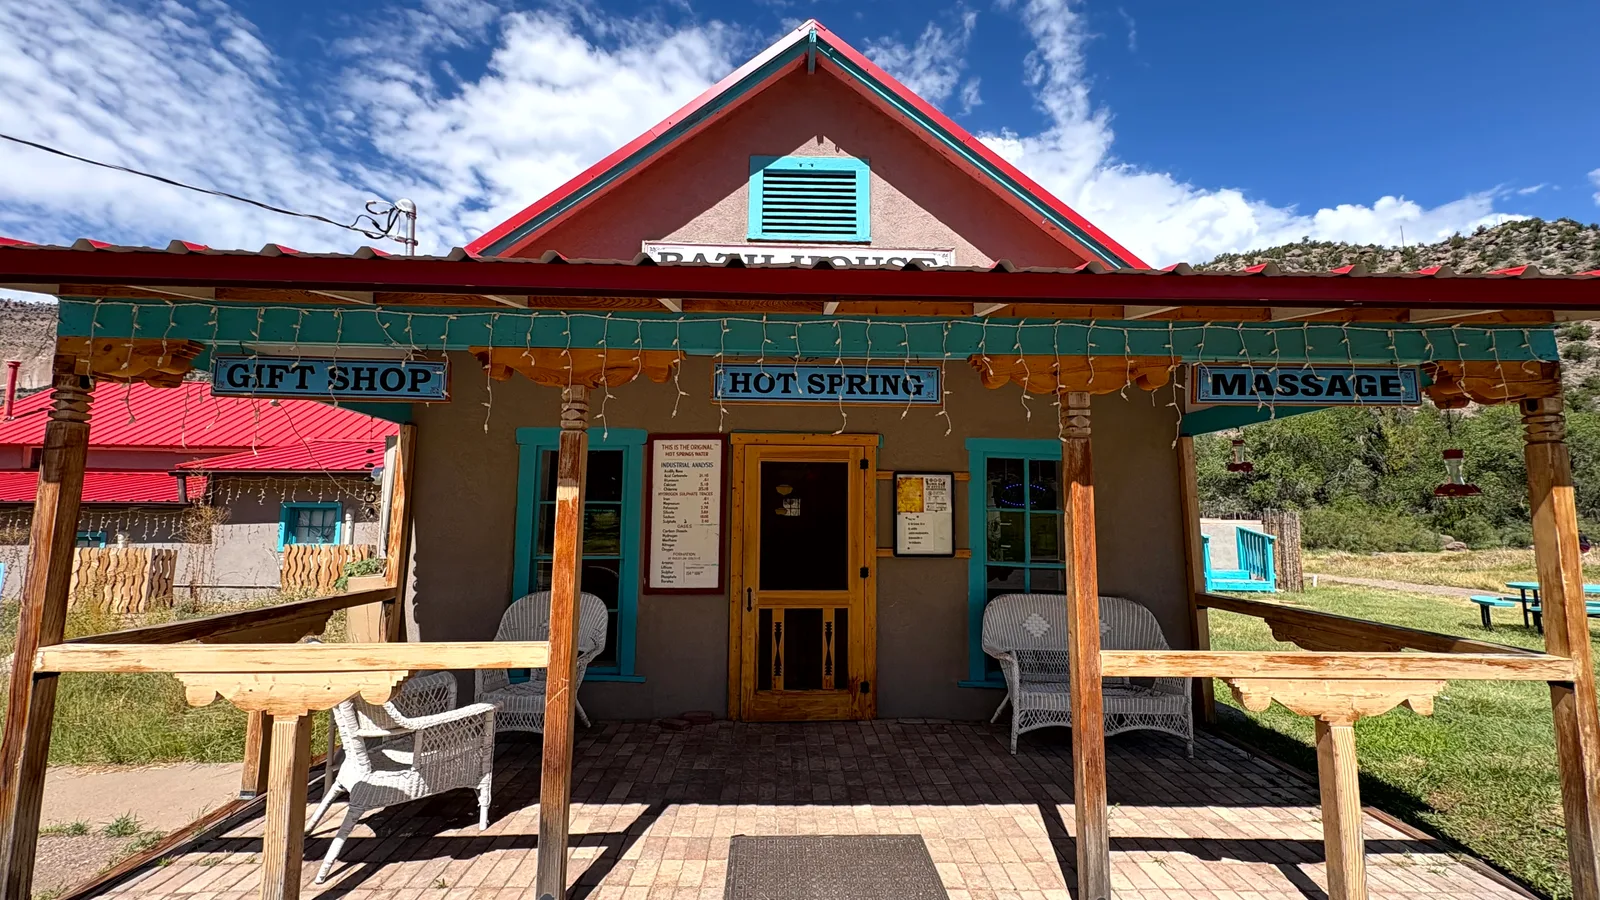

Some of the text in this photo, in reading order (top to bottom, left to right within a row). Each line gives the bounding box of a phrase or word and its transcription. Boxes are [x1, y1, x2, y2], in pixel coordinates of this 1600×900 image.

[226, 363, 432, 393] GIFT SHOP
[728, 372, 924, 396] HOT SPRING
[1211, 373, 1403, 397] MASSAGE
